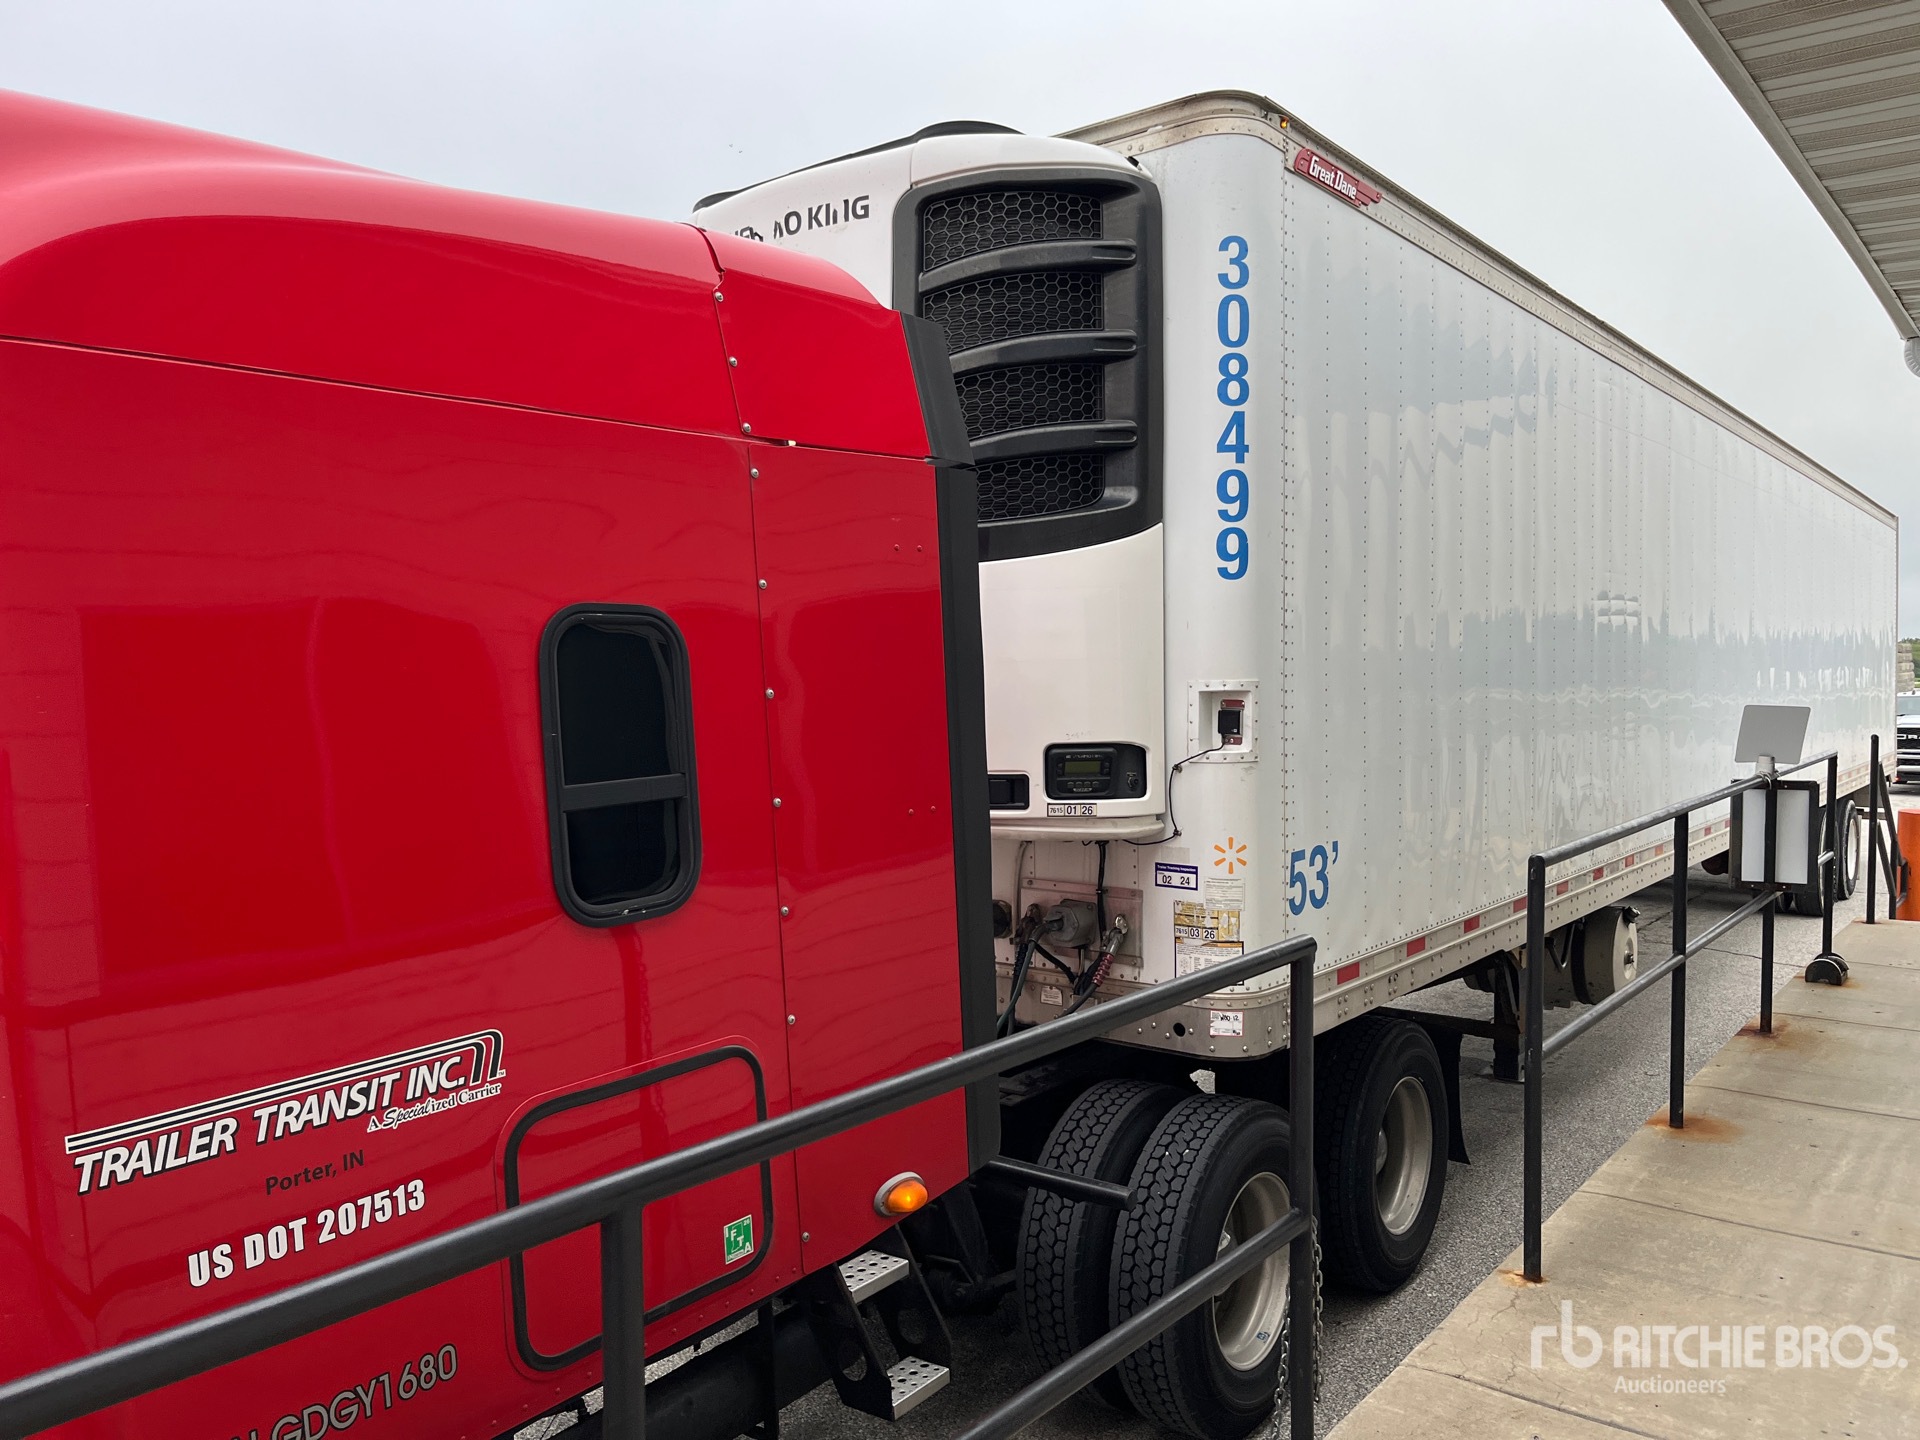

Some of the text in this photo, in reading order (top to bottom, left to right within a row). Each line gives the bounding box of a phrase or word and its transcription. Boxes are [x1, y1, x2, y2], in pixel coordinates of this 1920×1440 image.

[1309, 155, 1357, 200] Great Dane
[1216, 235, 1250, 580] 308499
[1066, 805, 1077, 815] 01
[1082, 805, 1093, 815] 26
[1162, 874, 1190, 885] 02 24
[1288, 841, 1338, 915] 53'
[1190, 928, 1200, 938] 03
[1204, 930, 1215, 939] 26
[74, 1117, 239, 1195] TRAILER
[253, 1071, 402, 1145] TRANSIT
[405, 1055, 466, 1103] INC.
[368, 1083, 501, 1132] A Specialized Carrier
[265, 1149, 365, 1195] Porter, IN
[188, 1178, 426, 1288] US DOT 207513
